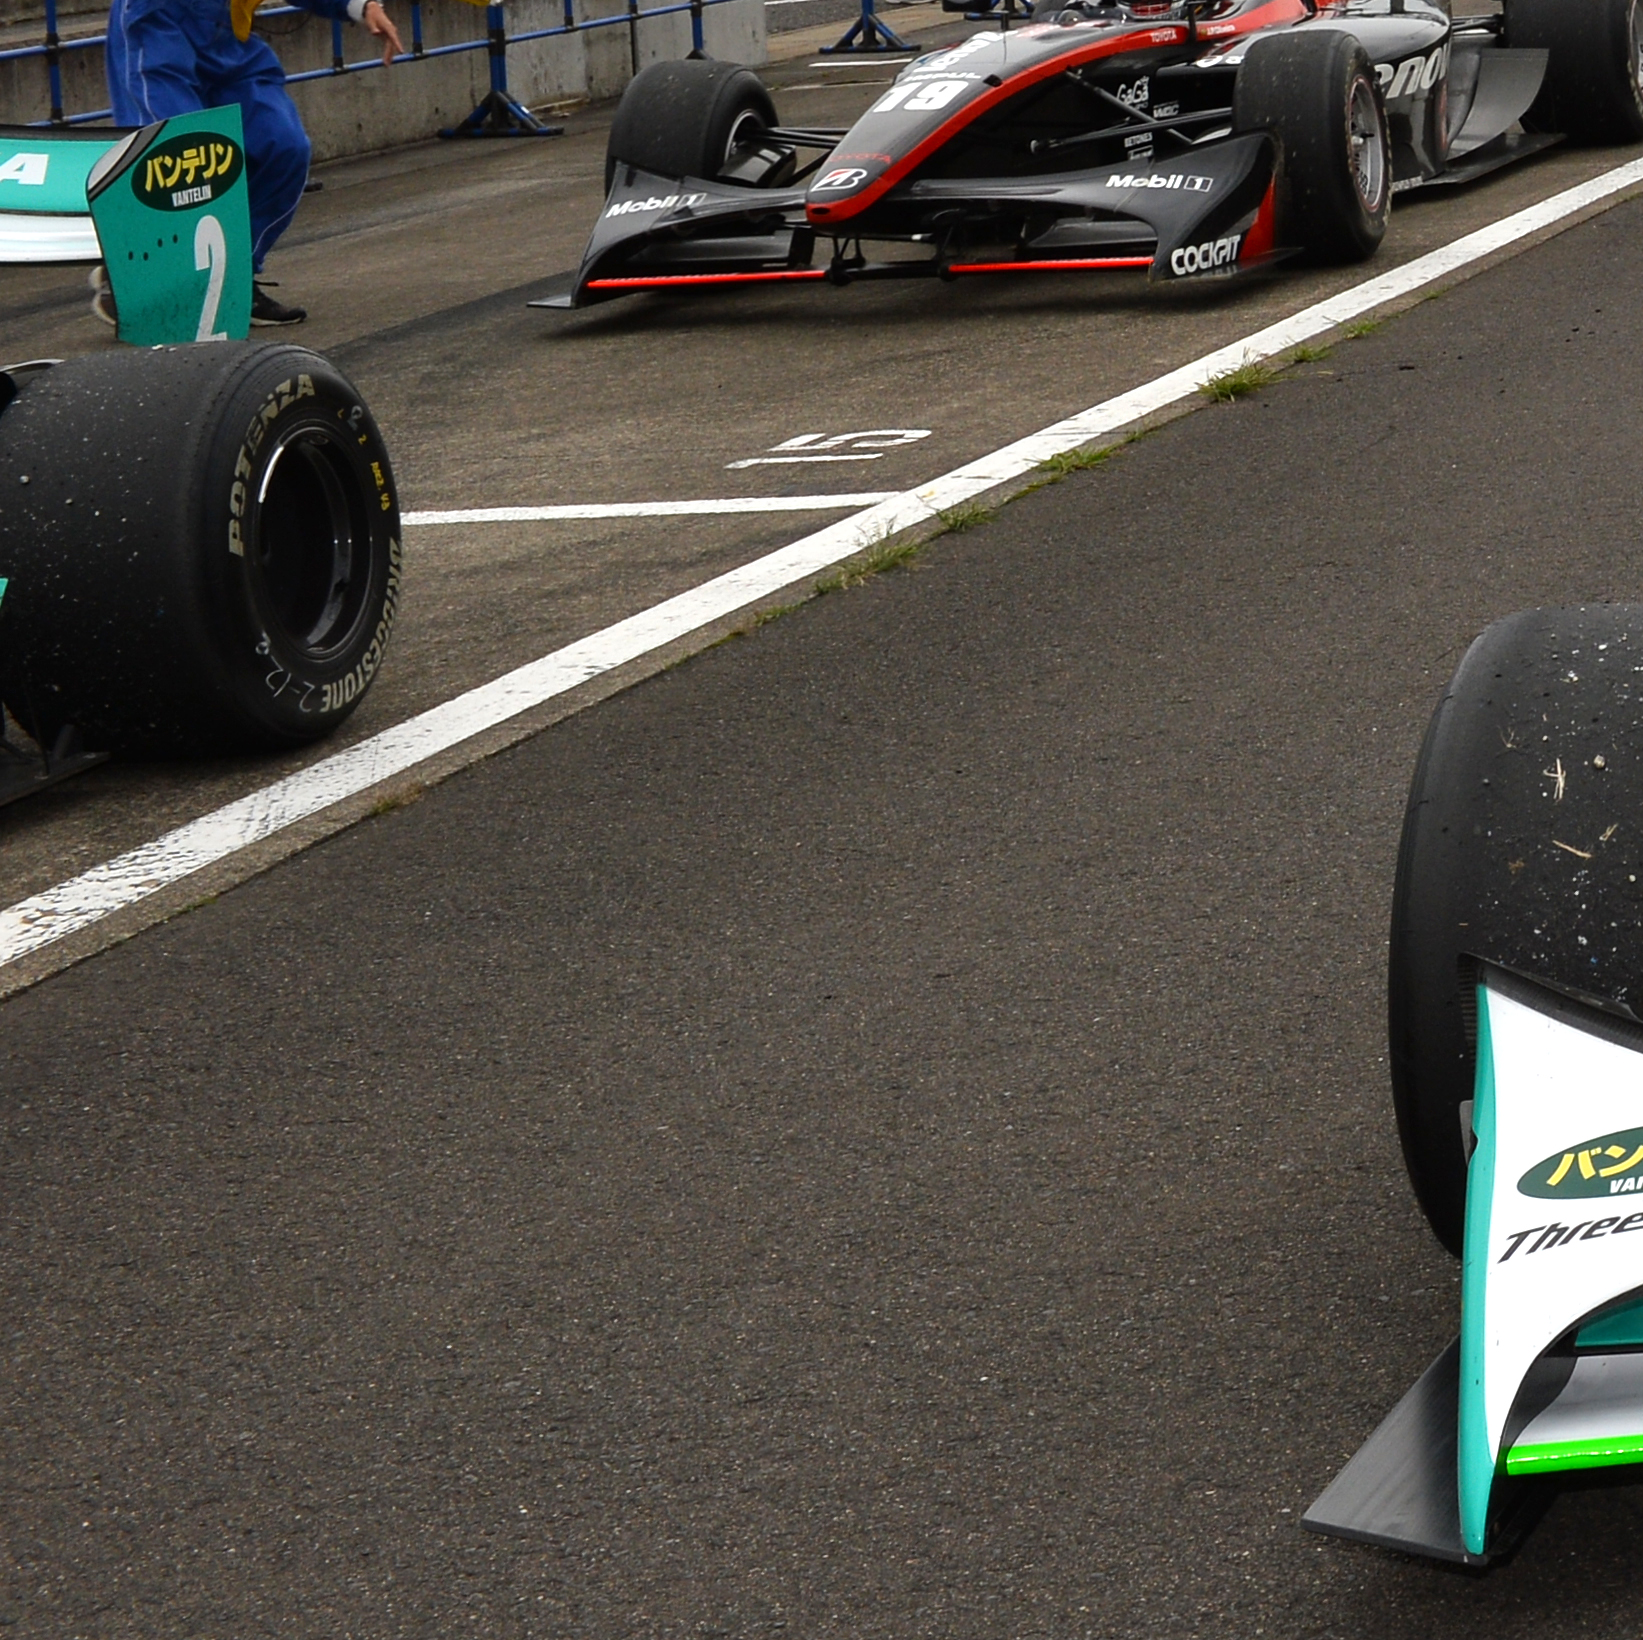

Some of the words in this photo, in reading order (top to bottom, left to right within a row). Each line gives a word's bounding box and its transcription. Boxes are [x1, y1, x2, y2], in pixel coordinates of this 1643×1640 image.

[1150, 27, 1177, 43] TOYOTA
[873, 79, 970, 113] 19
[144, 142, 235, 192] バンテリン
[1106, 174, 1183, 189] Mobil
[171, 184, 212, 208] VANTELIN
[606, 192, 678, 218] Mobil
[1171, 233, 1242, 278] COCKPIT
[194, 215, 227, 342] 2
[228, 373, 316, 557] POTENZA
